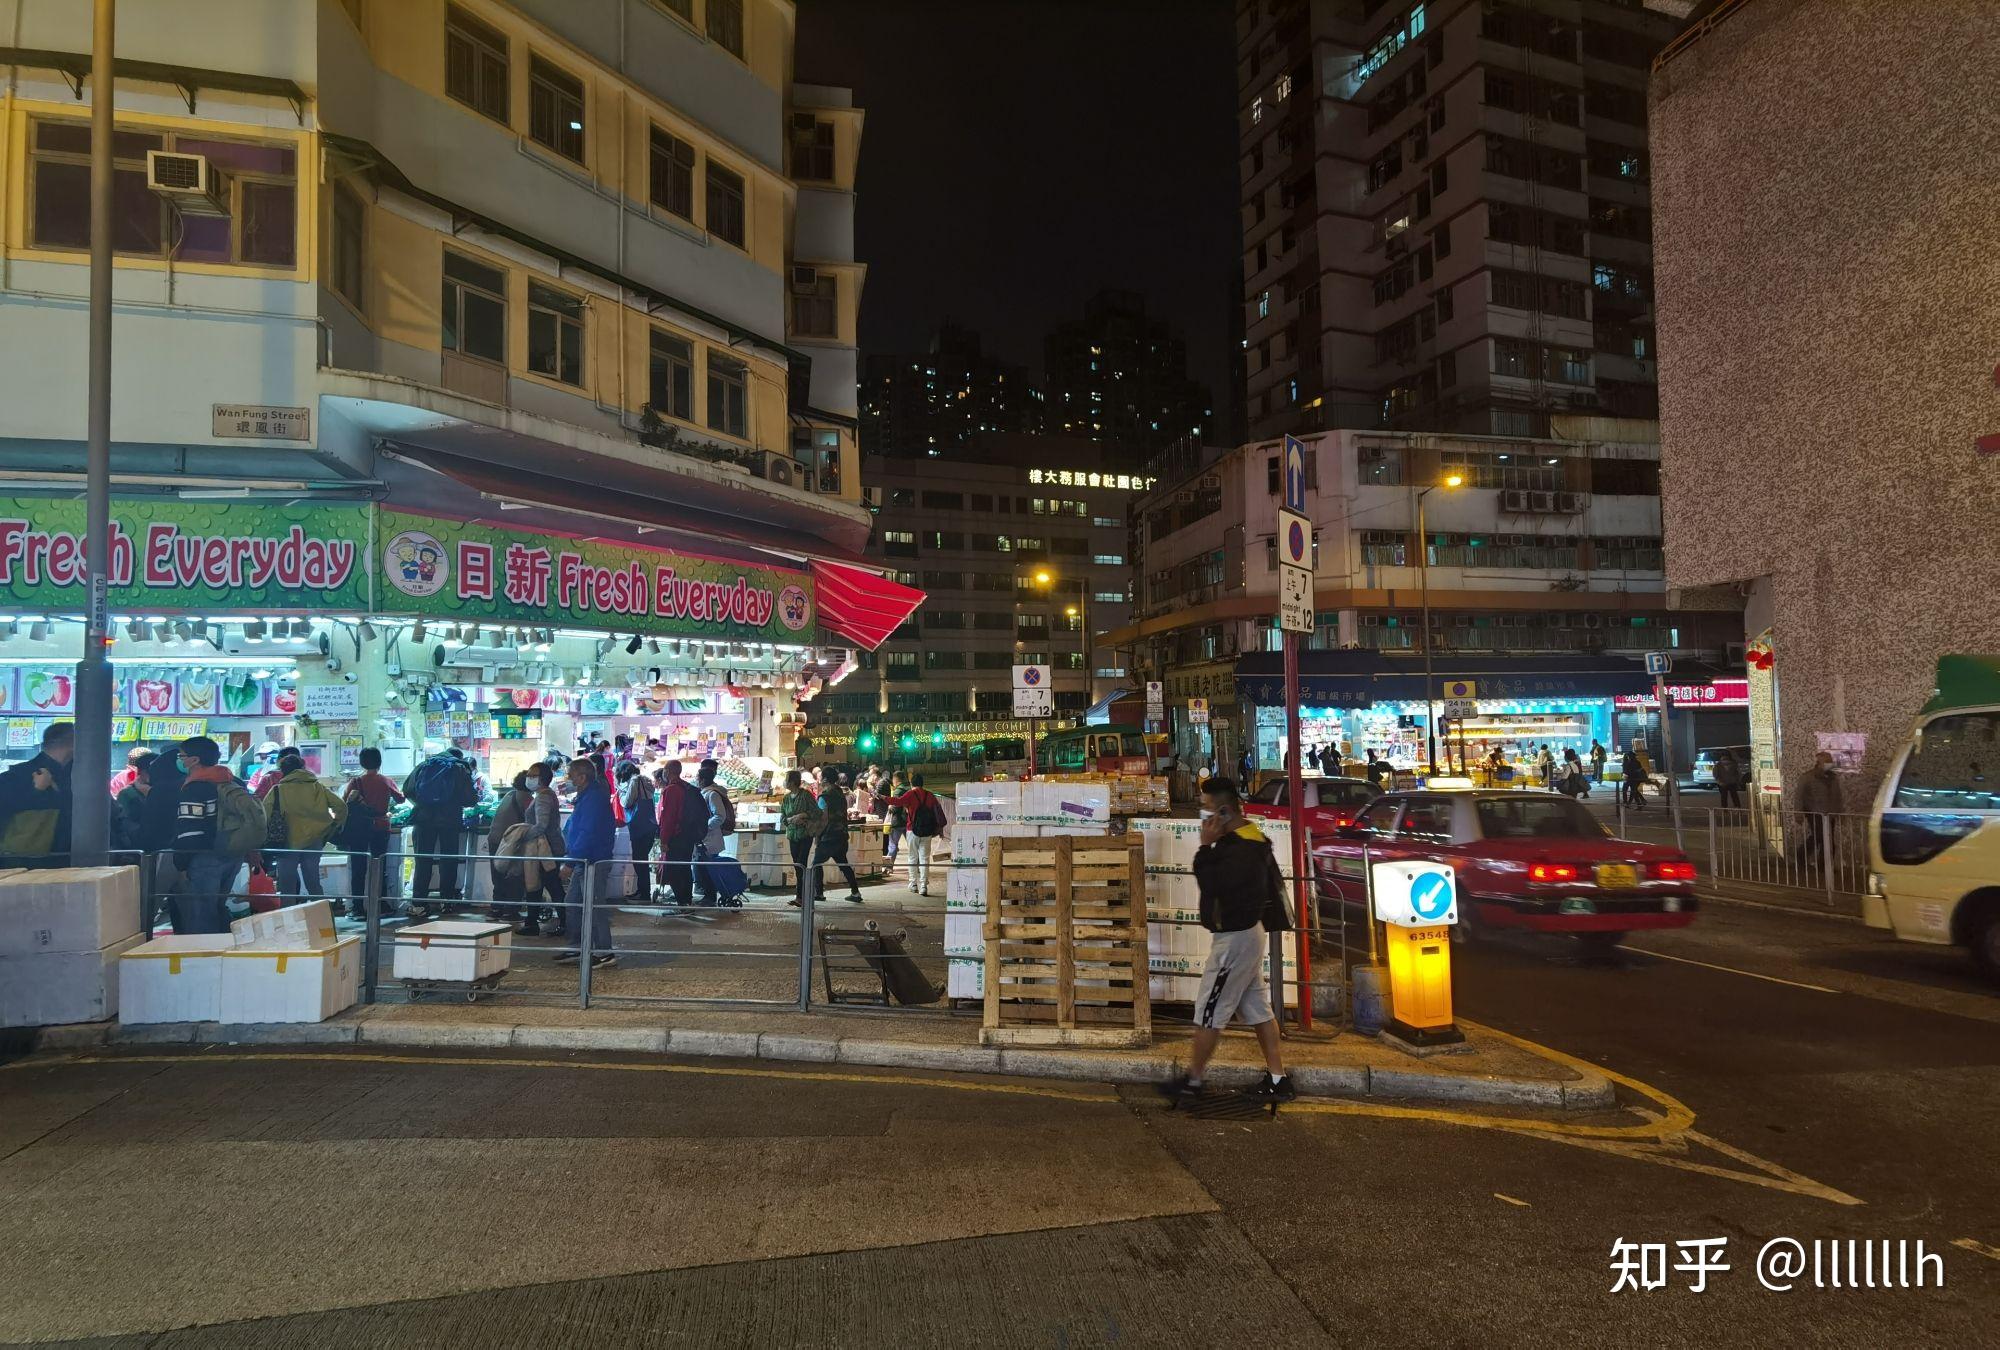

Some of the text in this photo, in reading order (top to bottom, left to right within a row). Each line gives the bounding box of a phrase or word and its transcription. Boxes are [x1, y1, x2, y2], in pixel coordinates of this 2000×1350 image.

[216, 408, 306, 420] Wan Fung Street
[144, 522, 354, 590] Everyday
[457, 540, 551, 601] 日新
[557, 551, 774, 628] Fresh Everyday
[1301, 573, 1307, 594] 7
[1282, 601, 1301, 614] midnight
[1302, 608, 1312, 630] 12
[1038, 690, 1044, 700] 7
[1039, 706, 1050, 715] 12
[1451, 708, 1471, 716] 全日
[1410, 930, 1449, 941] 63548
